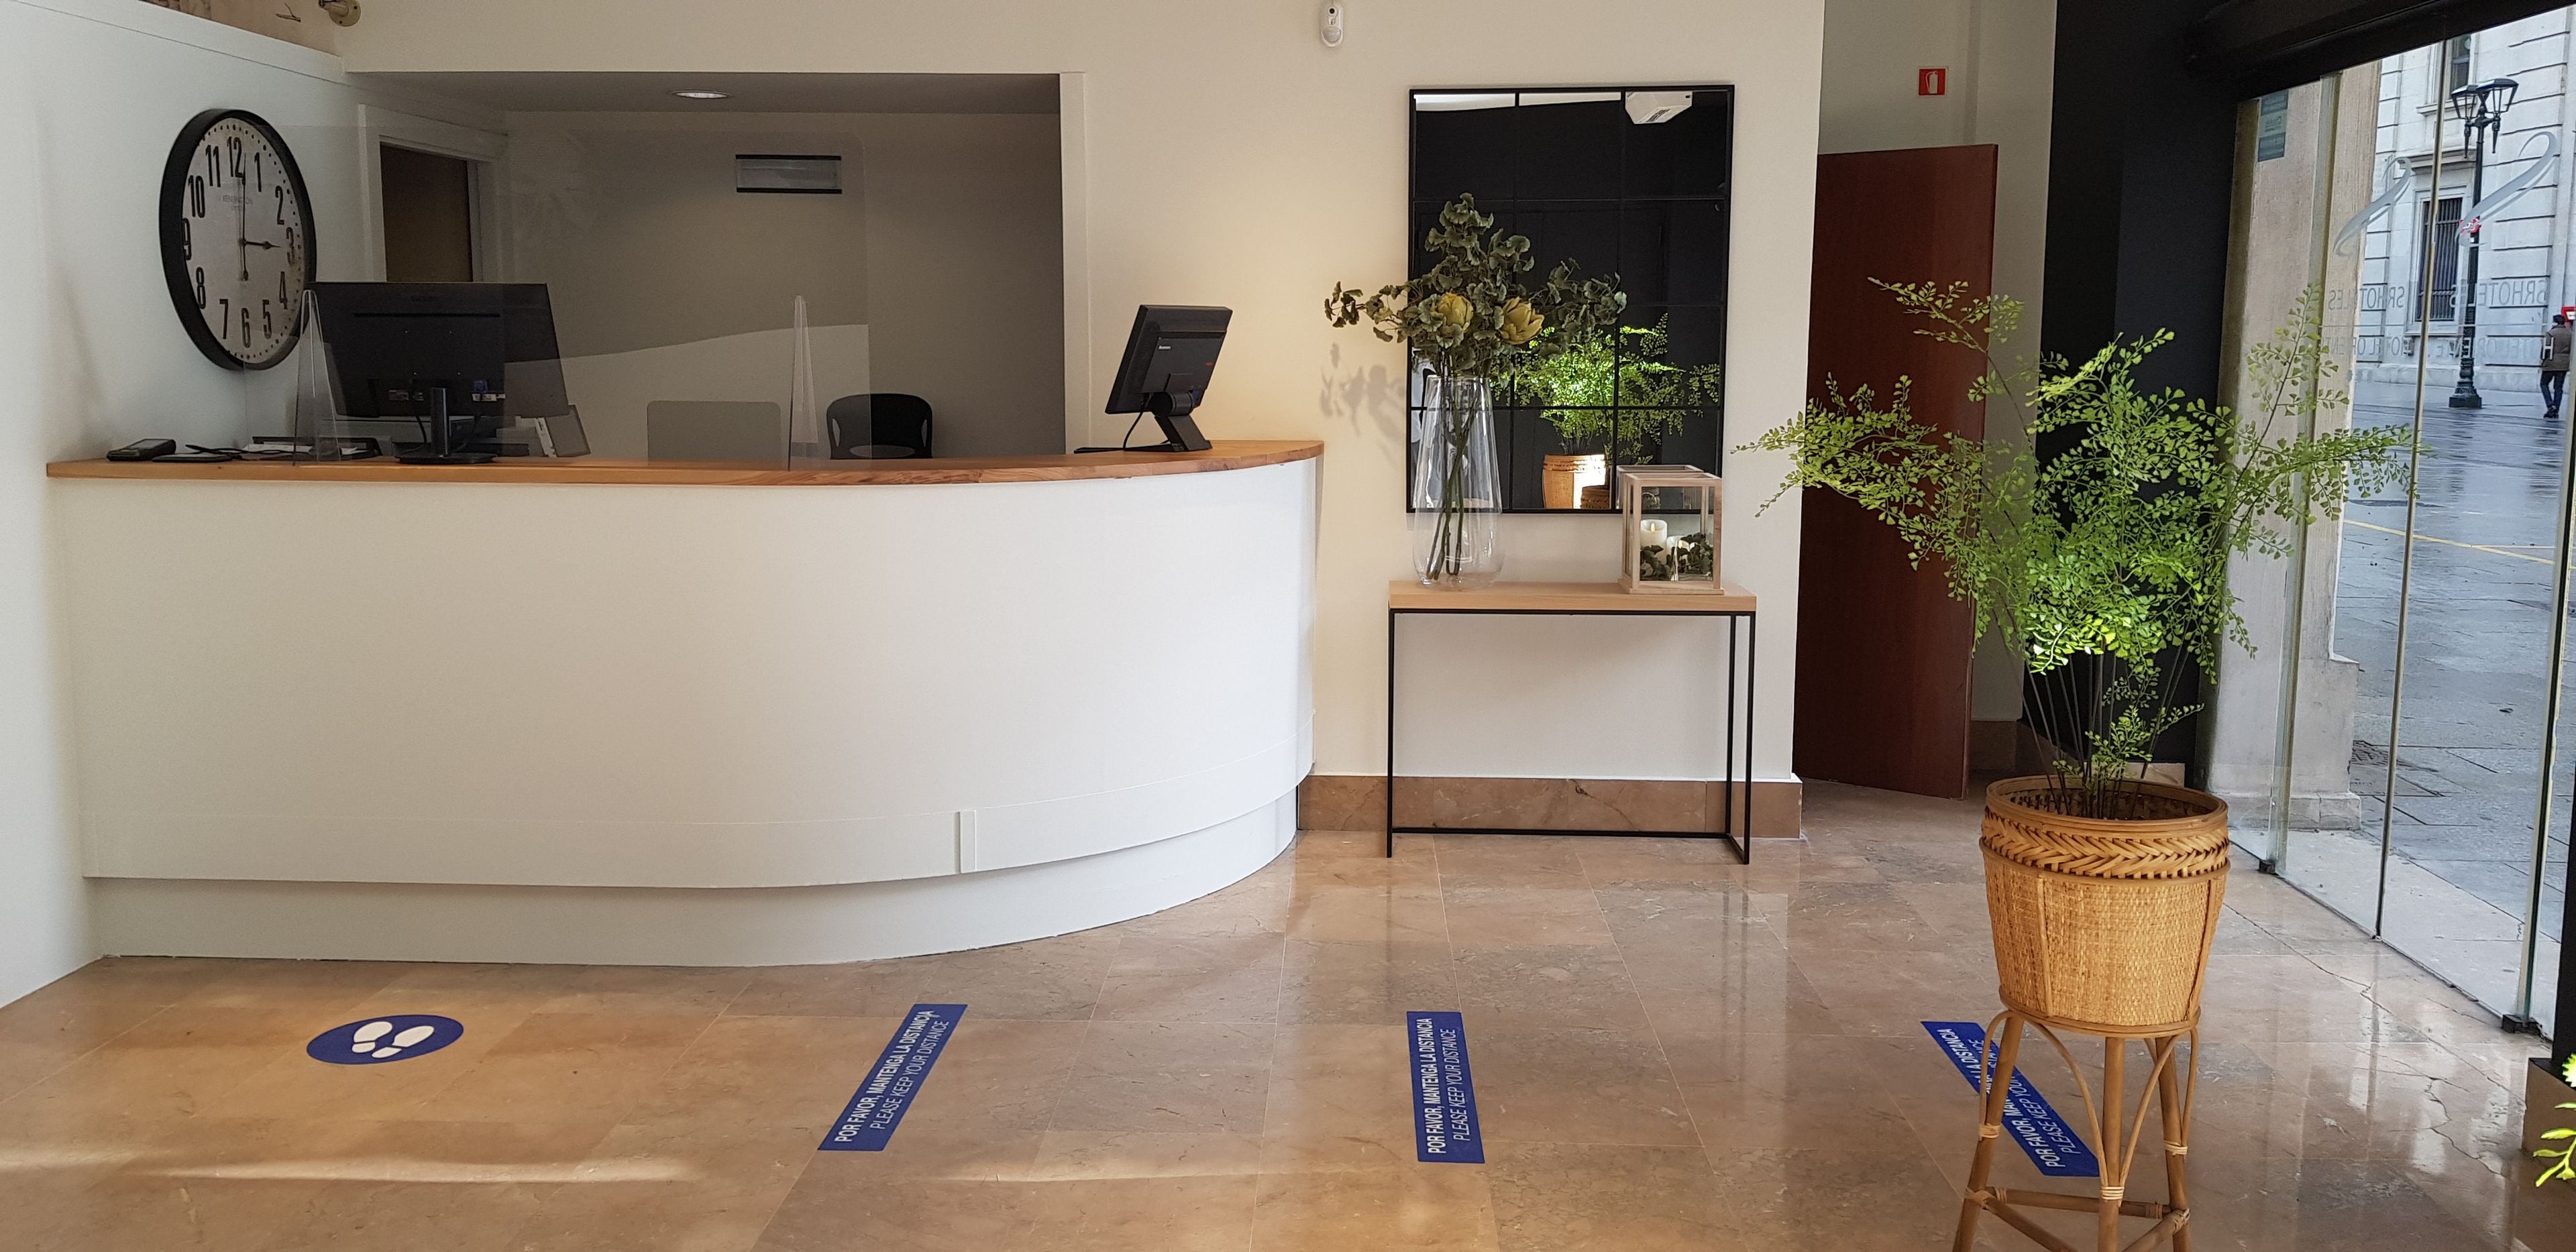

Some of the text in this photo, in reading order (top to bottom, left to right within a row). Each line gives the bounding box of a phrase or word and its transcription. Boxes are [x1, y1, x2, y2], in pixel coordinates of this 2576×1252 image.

[205, 144, 221, 188] 11
[227, 136, 244, 178] 12
[254, 152, 262, 192] 1
[188, 175, 205, 218] 10
[275, 185, 284, 225] 2
[182, 218, 192, 261] 9
[286, 227, 296, 267] 3
[196, 267, 206, 309] 8
[279, 271, 288, 310] 4
[219, 299, 229, 339] 7
[241, 307, 251, 348] 6
[262, 299, 272, 339] 5
[1937, 1029, 1979, 1064] DISTANCIA
[834, 1010, 934, 1141] POR FAVOR, MANTENGA LA DISTANCIA
[869, 1021, 949, 1129] PLEASE KEEP YOUR DISTANCE
[1416, 1018, 1446, 1153] POR FAVOR, MANTENGA LA DISTANCIA
[1440, 1029, 1470, 1141] PLEASE KEEP YOUR DISTANCE
[2008, 1076, 2081, 1154] PLEASE KEEP YOU
[2011, 1118, 2049, 1147] FAVOR,
[2035, 1148, 2066, 1168] POR
